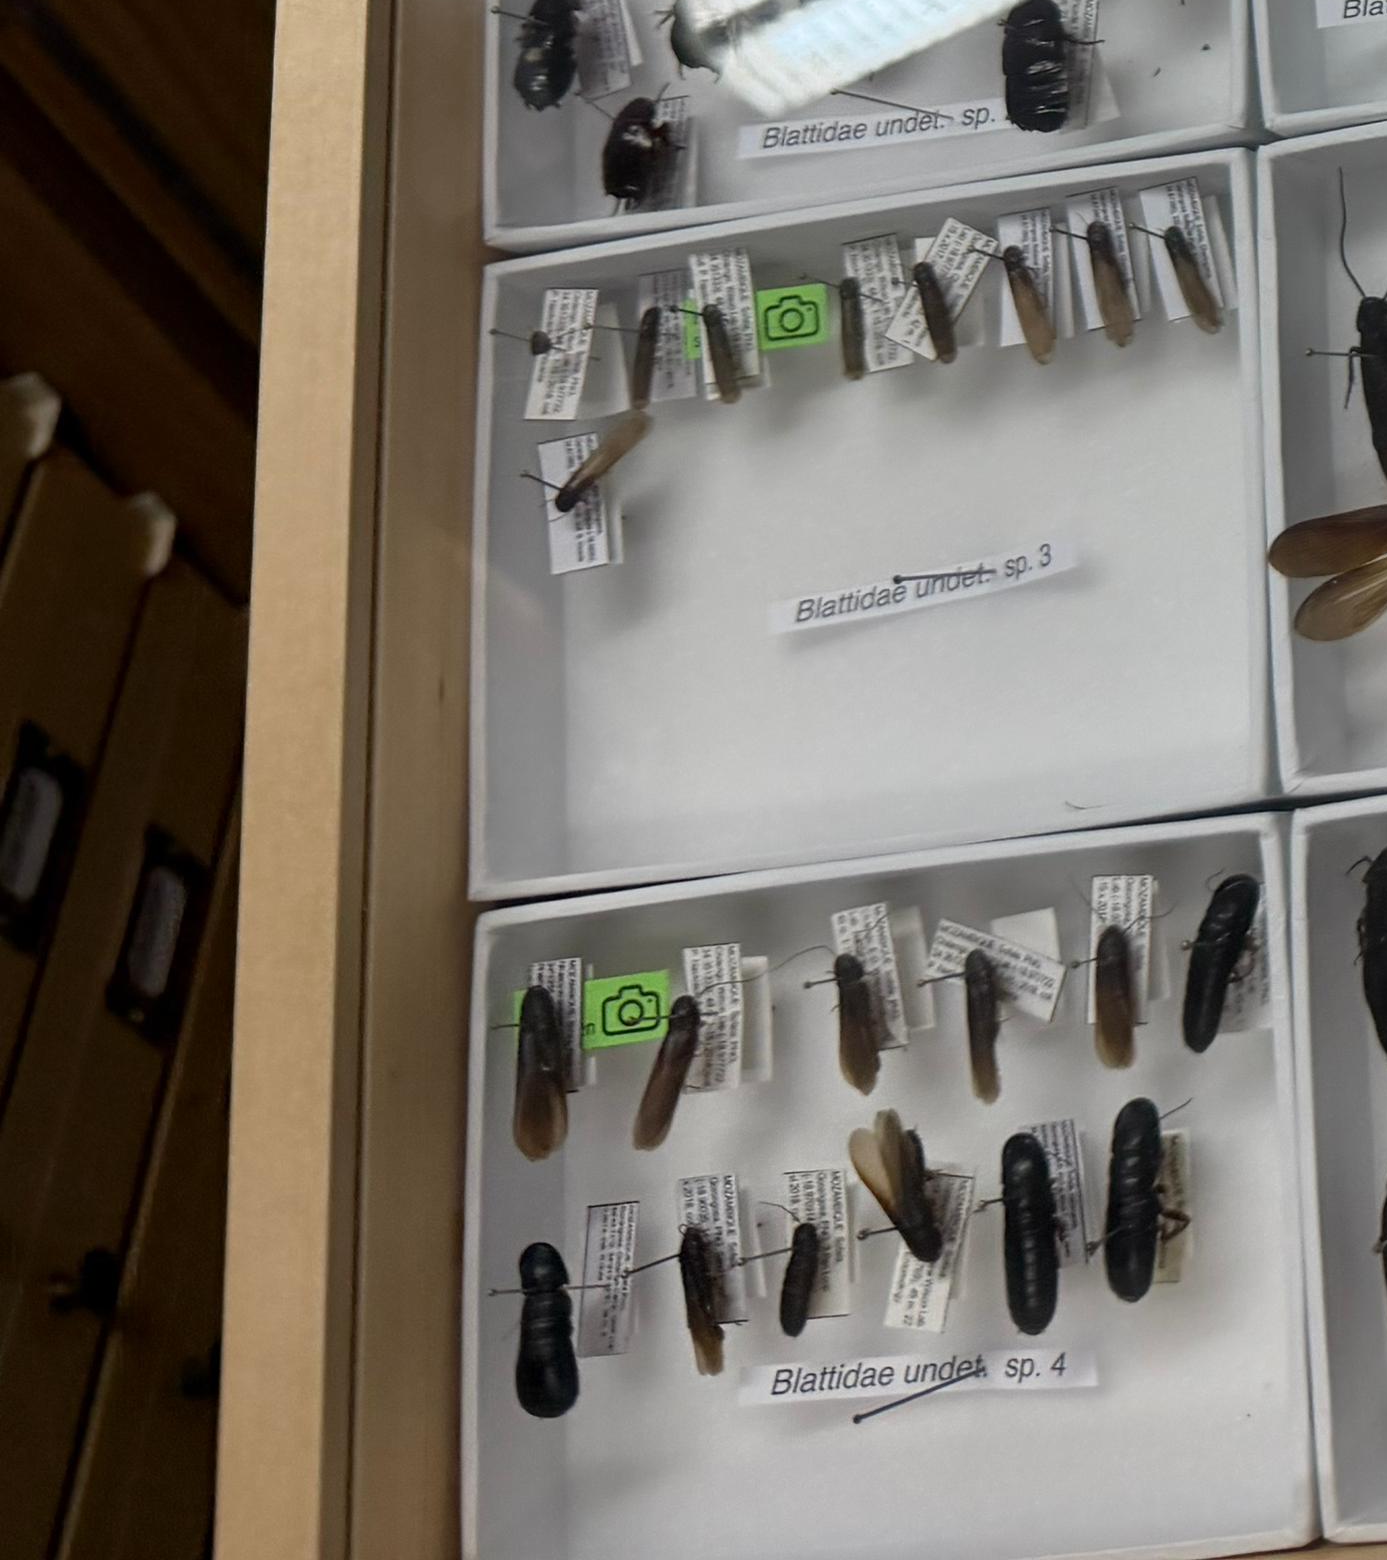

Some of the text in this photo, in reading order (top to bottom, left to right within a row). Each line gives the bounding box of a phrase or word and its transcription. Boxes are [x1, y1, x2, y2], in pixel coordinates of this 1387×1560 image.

[762, 106, 996, 149] Blattidae undet. sp.
[795, 585, 907, 623] Blattidae
[1003, 555, 1032, 580] sp.
[1039, 543, 1052, 567] 3
[770, 1352, 1067, 1395] Blattidae undet. sp. 4
